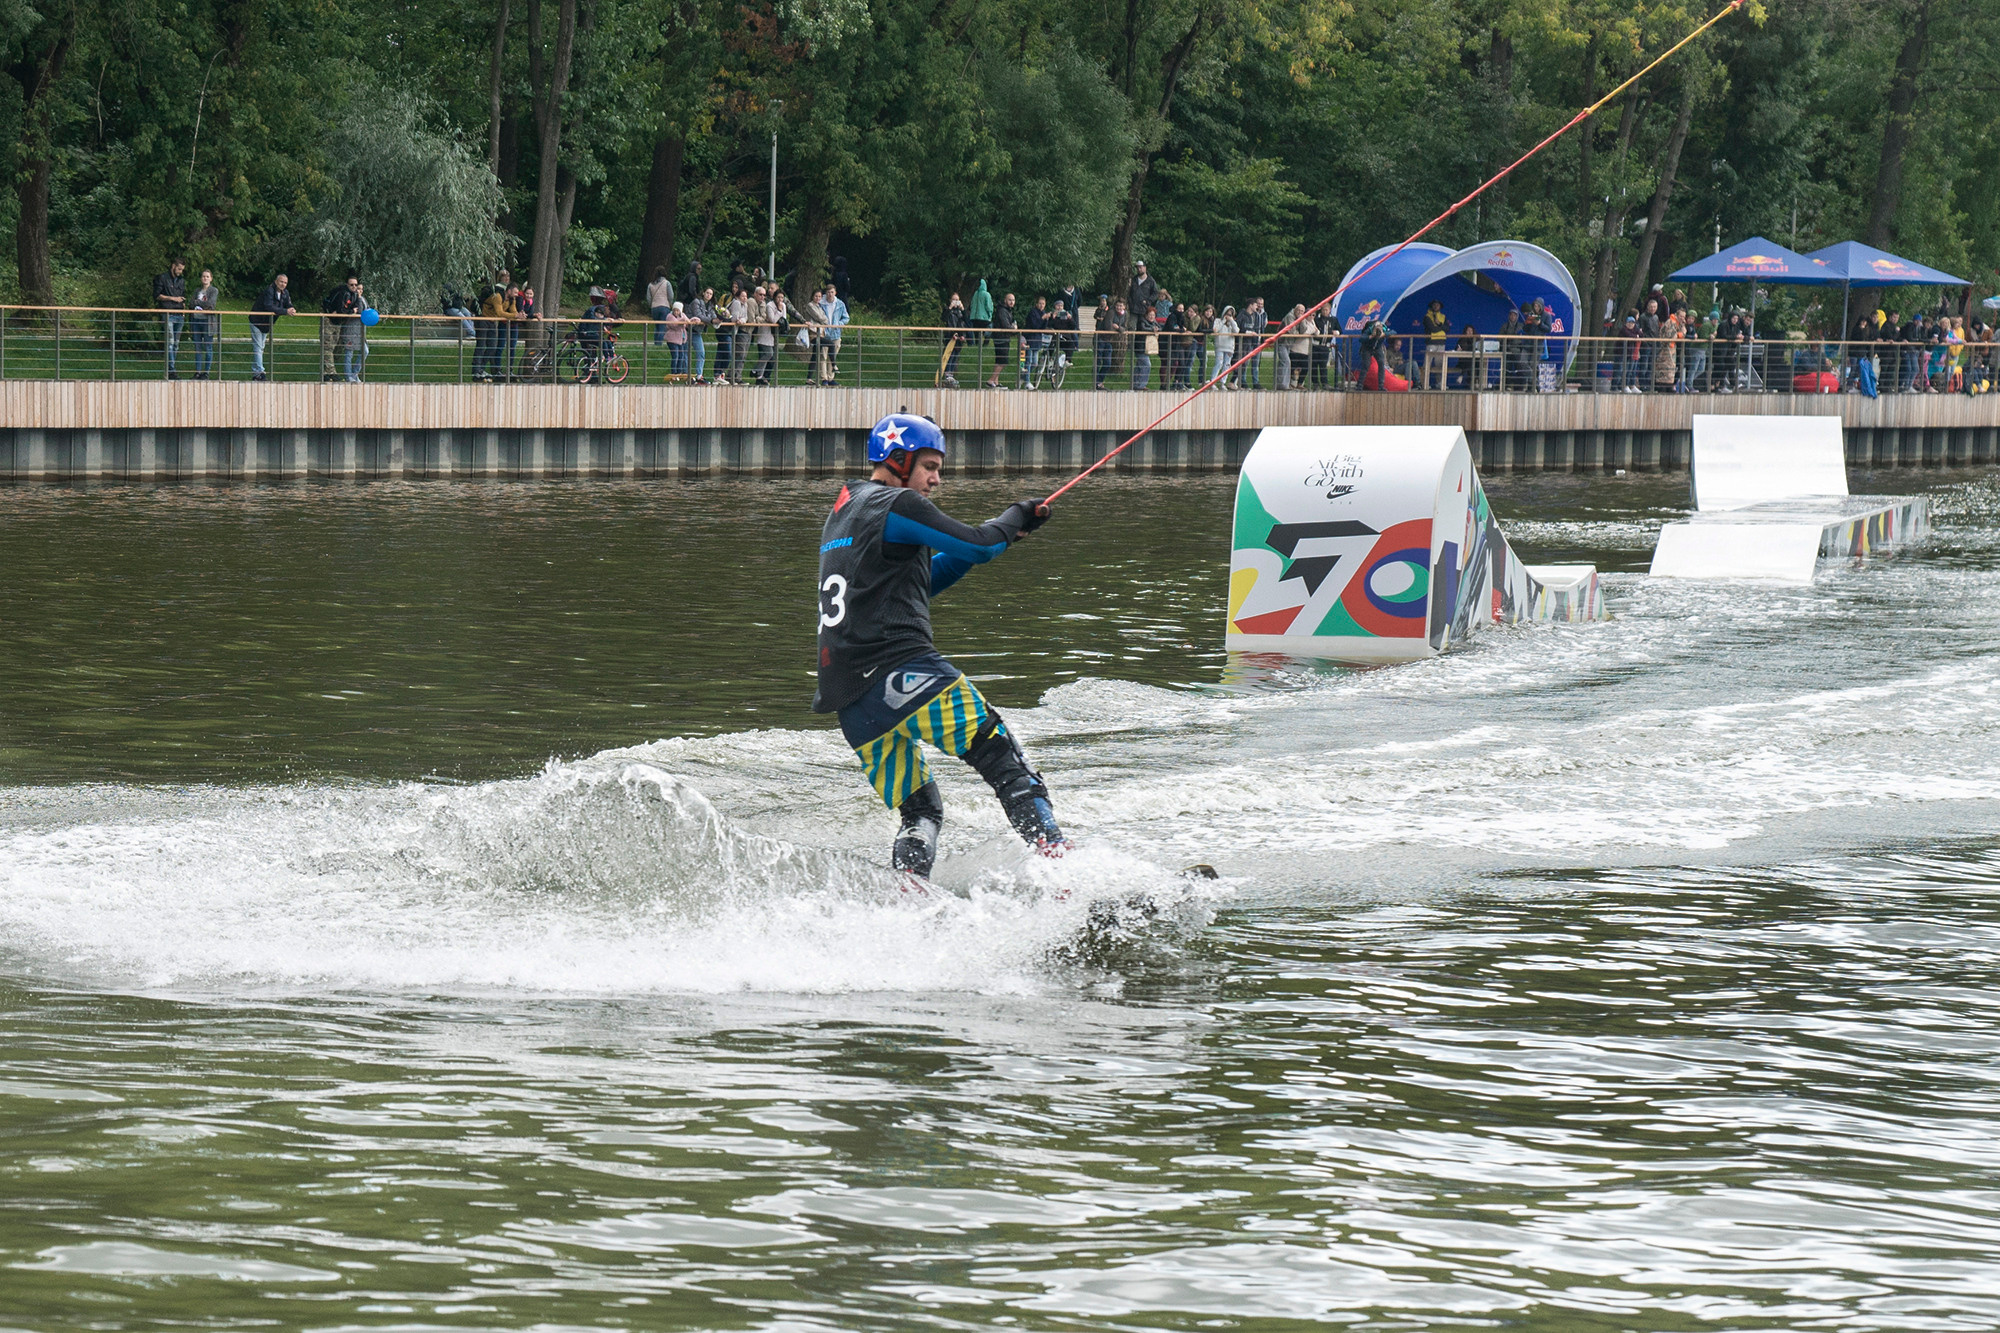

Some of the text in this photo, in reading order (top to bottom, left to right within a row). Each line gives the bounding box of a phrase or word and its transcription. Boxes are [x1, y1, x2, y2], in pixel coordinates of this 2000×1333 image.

[1726, 264, 1789, 273] Red Bull
[1324, 464, 1364, 478] With
[1332, 484, 1355, 493] NIKE
[1230, 518, 1434, 638] 270
[818, 574, 847, 635] 3
